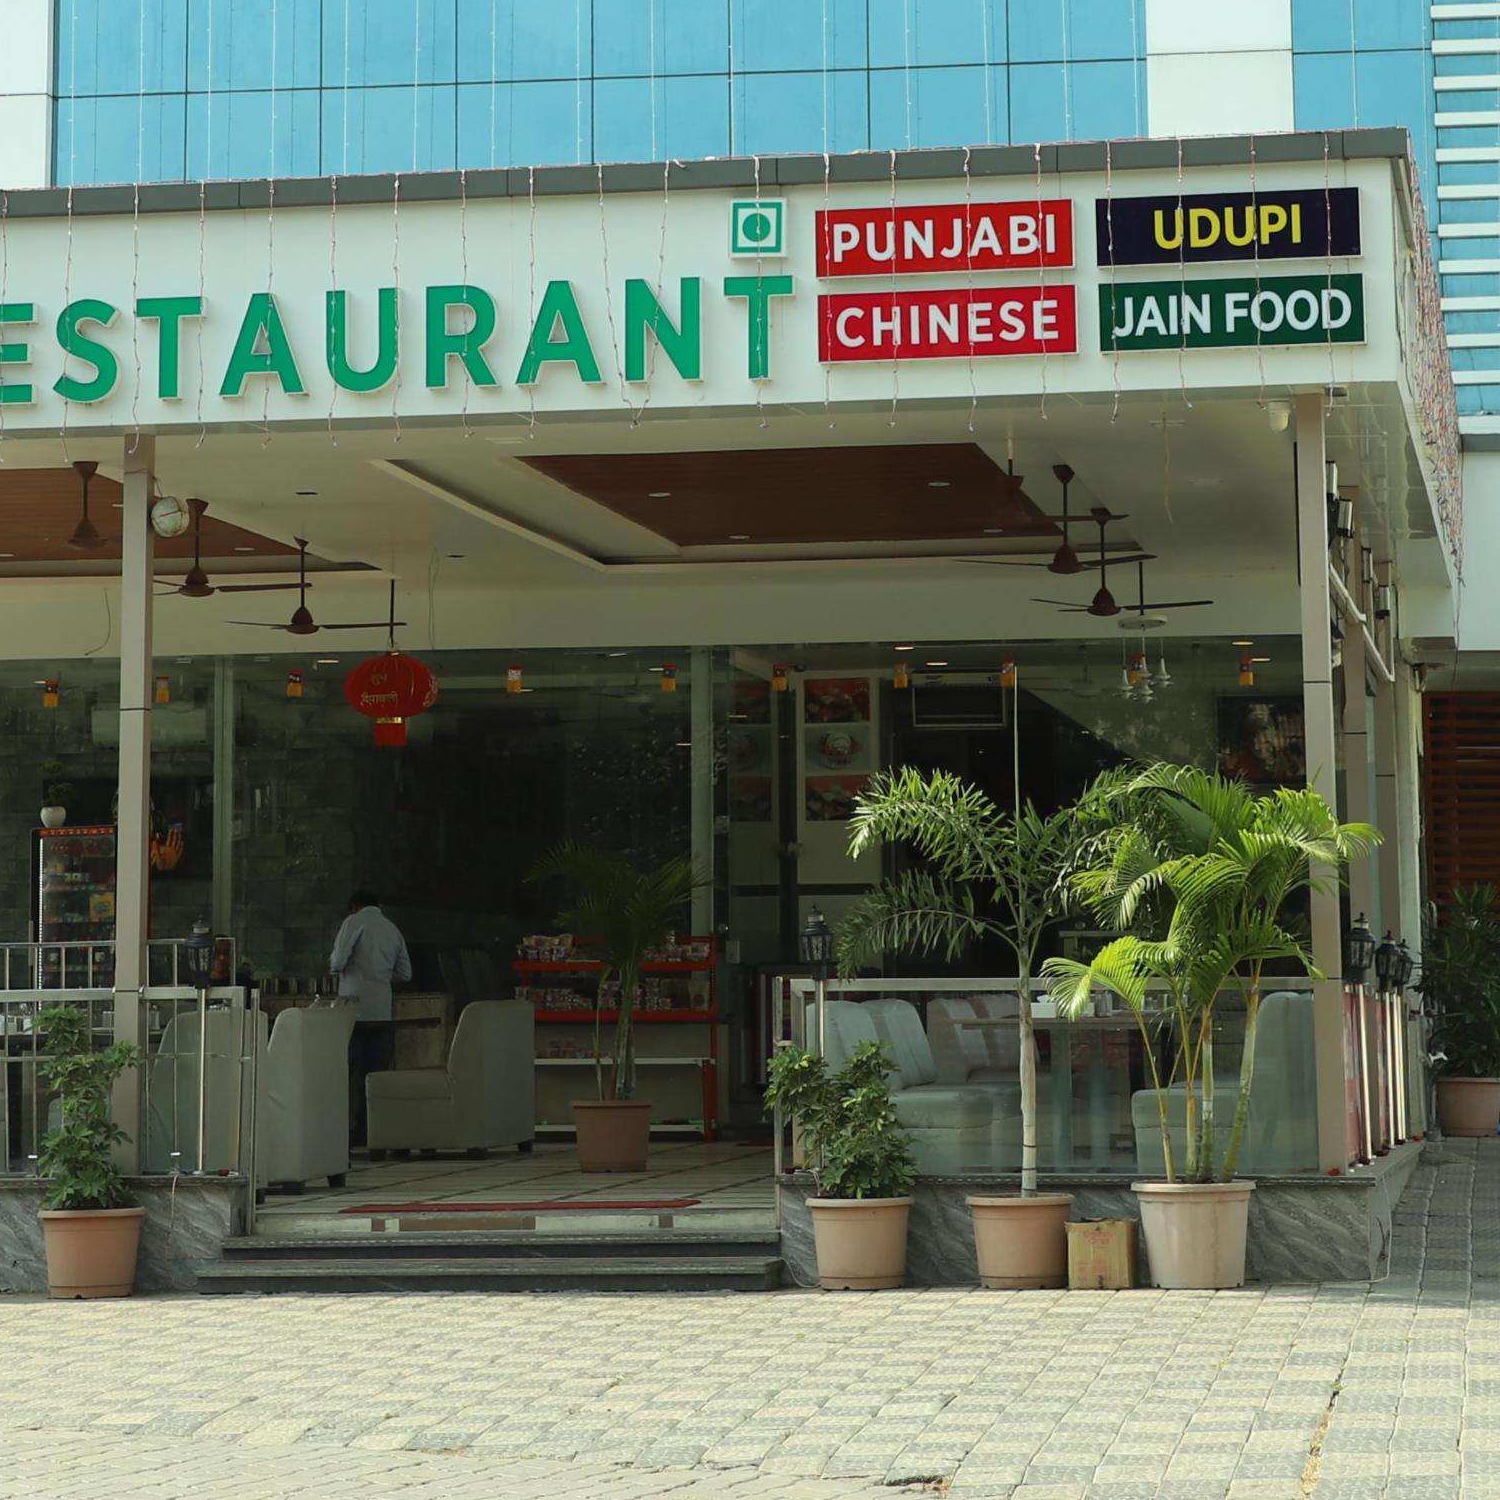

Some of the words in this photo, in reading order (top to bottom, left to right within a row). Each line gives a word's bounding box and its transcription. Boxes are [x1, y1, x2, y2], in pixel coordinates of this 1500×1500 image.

[833, 213, 1057, 263] PUNJABI
[1153, 204, 1302, 250] UDUPI
[835, 299, 1059, 348] CHINESE
[1113, 293, 1211, 337] JAIN
[1225, 288, 1351, 334] FOOD
